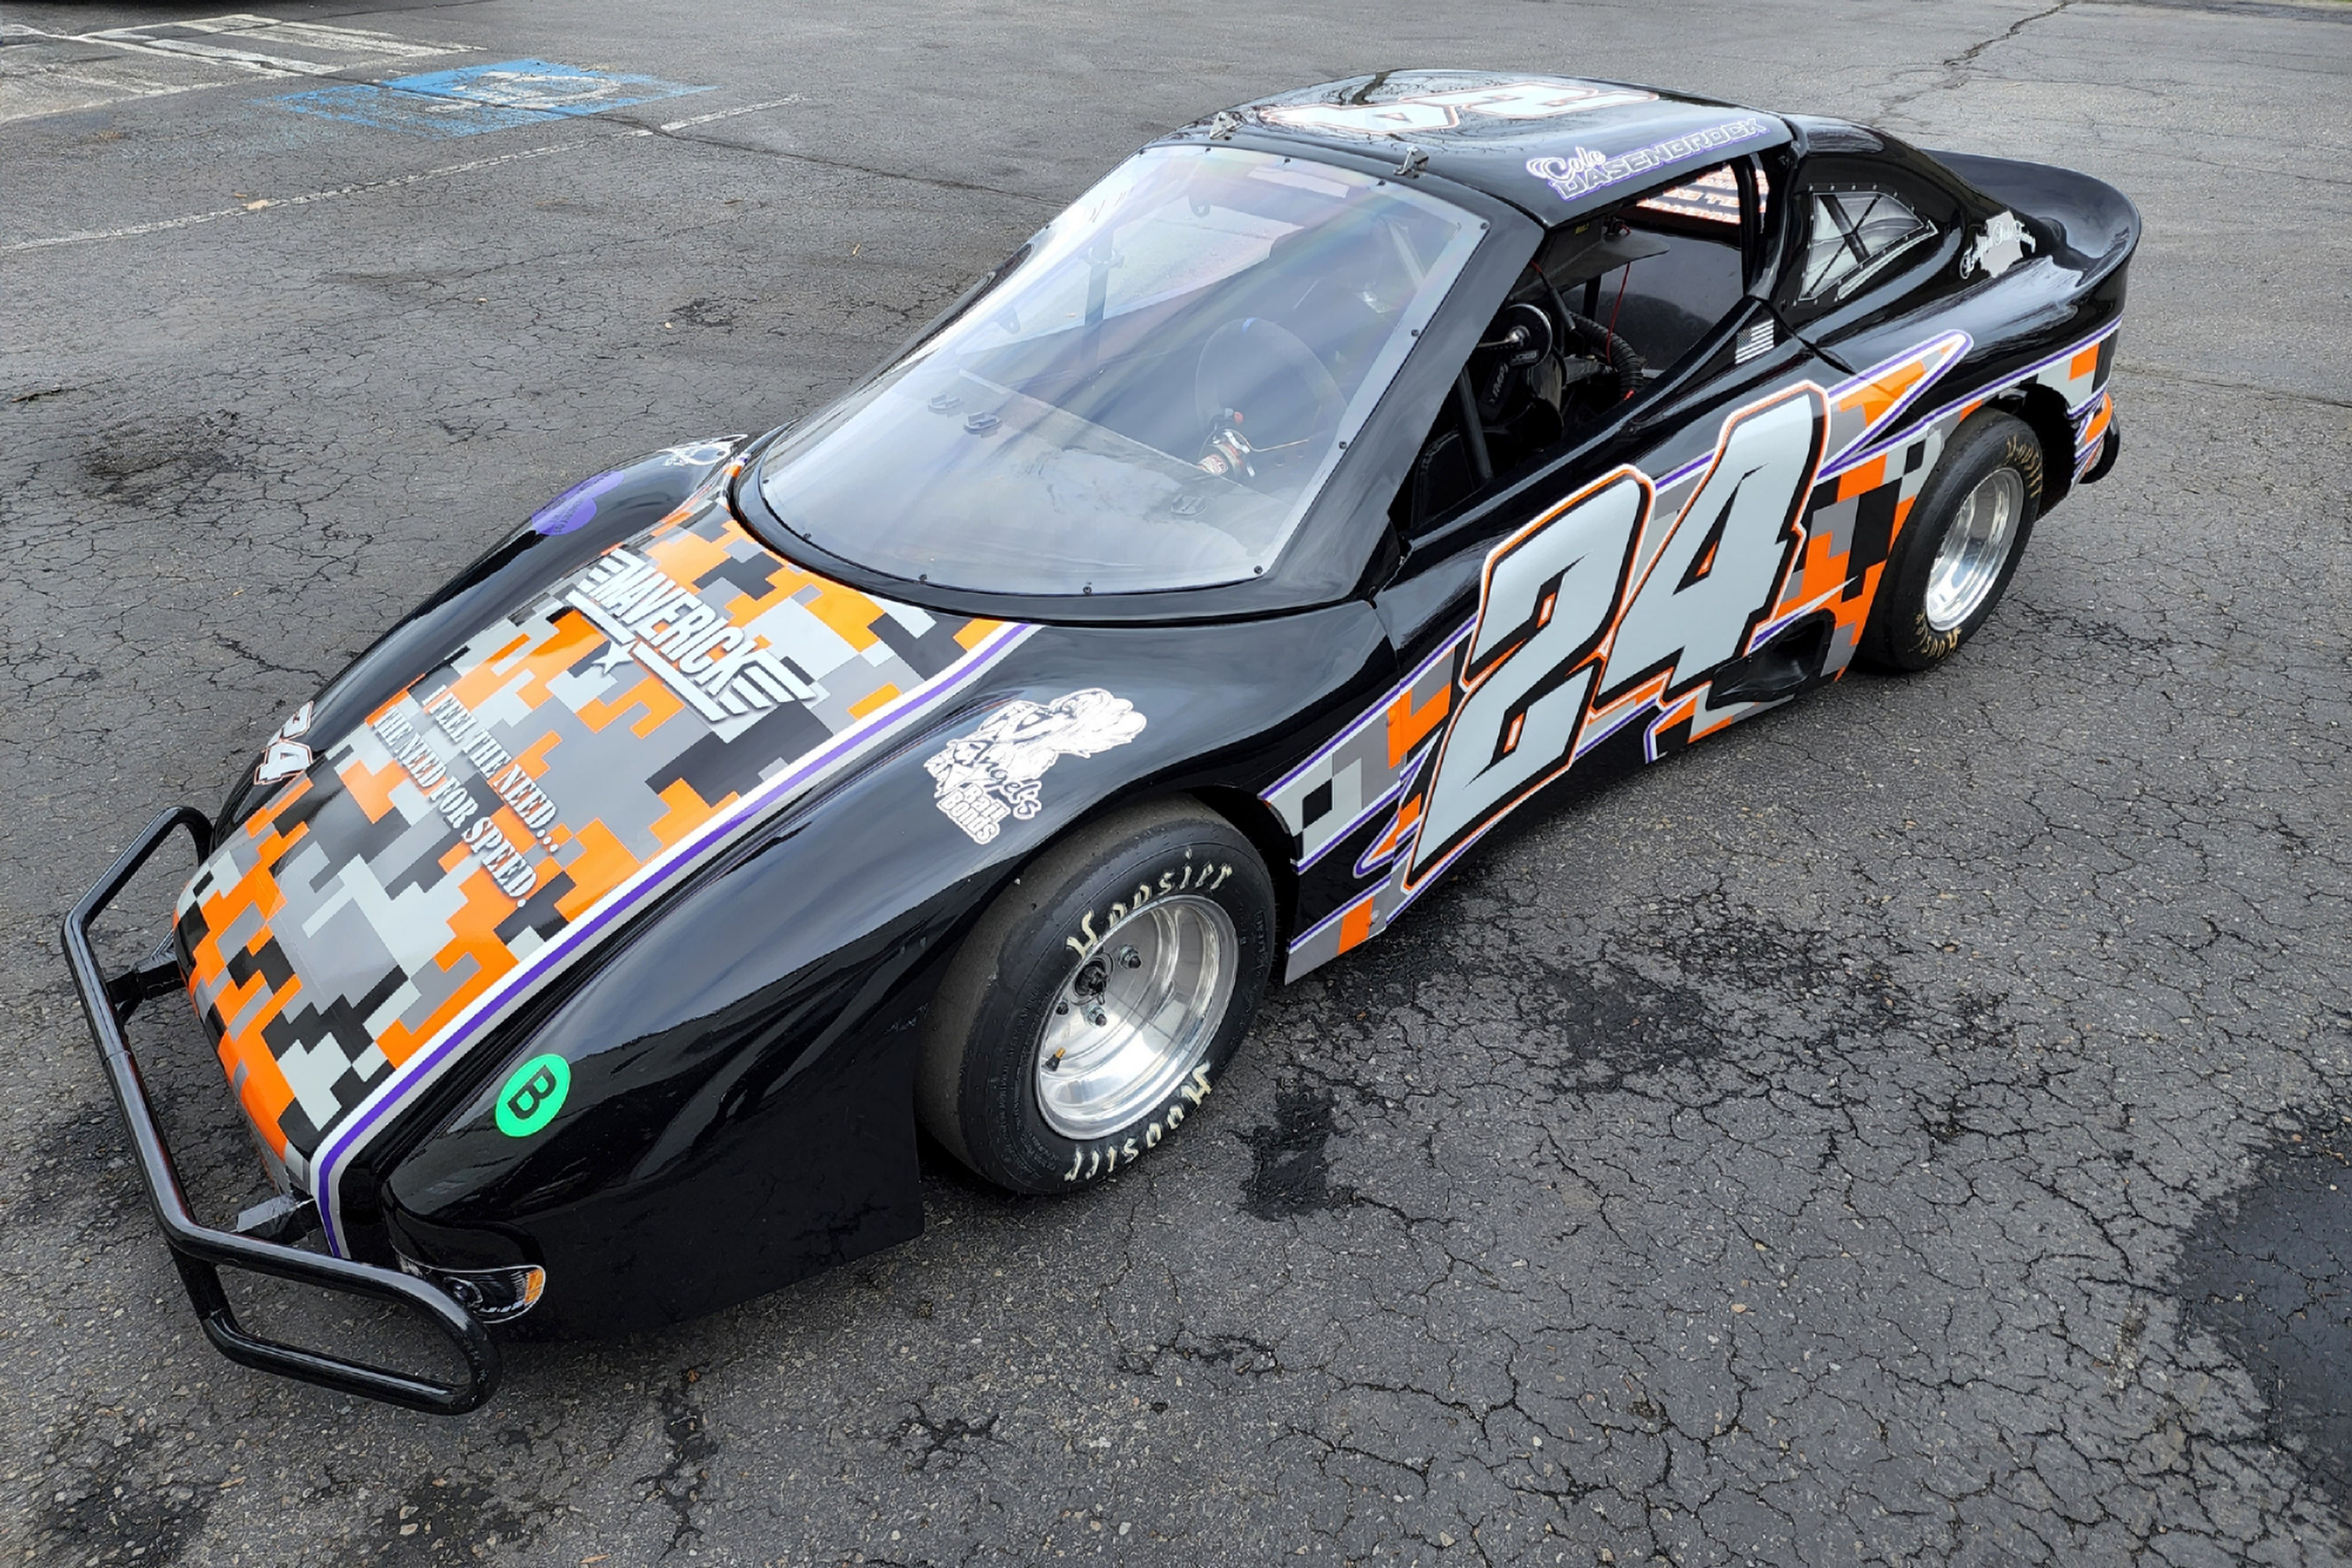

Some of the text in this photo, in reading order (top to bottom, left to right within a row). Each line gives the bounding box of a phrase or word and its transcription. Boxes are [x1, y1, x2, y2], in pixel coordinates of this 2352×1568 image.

[1526, 146, 1606, 180] Cole
[1549, 116, 1769, 201] DASENBROCK
[588, 561, 767, 696] MAVERICK
[1402, 379, 1830, 892] 24
[372, 706, 538, 908] THE NEED FOR SPEED.
[421, 684, 561, 854] I FEEL THE NEED...
[967, 783, 1009, 822] Bail
[940, 790, 1000, 843] Bonds
[507, 1065, 557, 1120] B
